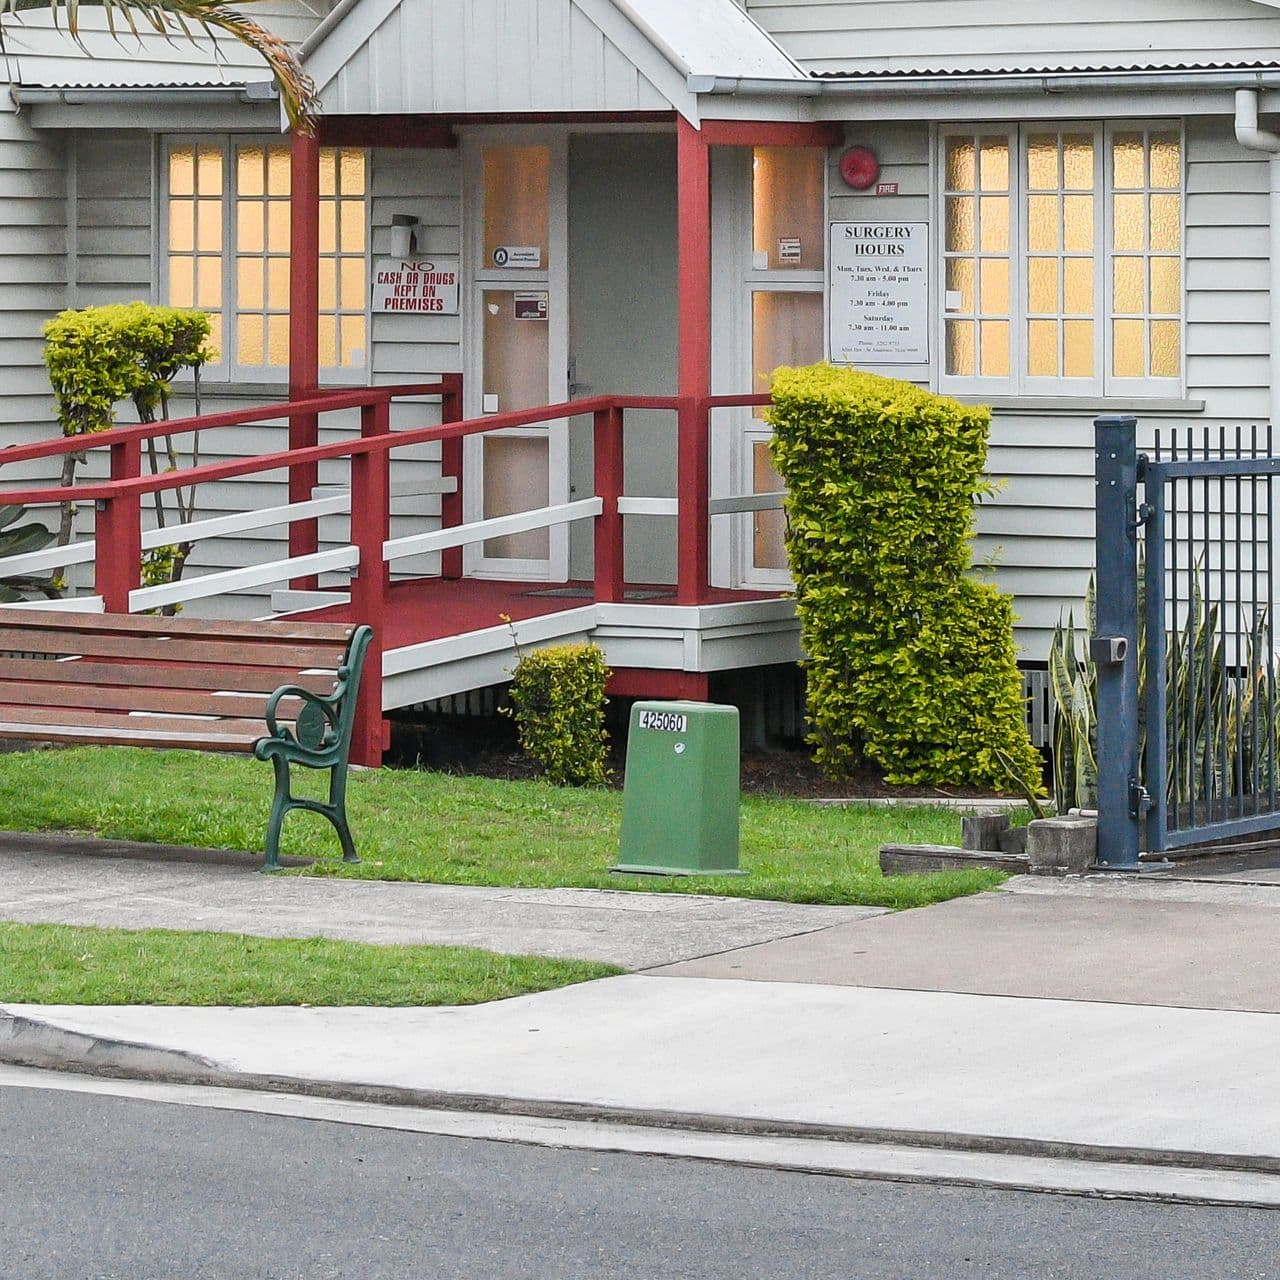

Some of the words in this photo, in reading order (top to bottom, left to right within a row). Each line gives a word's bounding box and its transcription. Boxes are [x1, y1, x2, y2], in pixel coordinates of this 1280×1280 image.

[844, 226, 914, 238] SURGERY
[855, 243, 905, 255] HOURS
[401, 262, 435, 272] NO
[377, 272, 402, 285] CASH
[406, 272, 419, 285] OR
[423, 272, 455, 285] DRUGS
[394, 285, 417, 297] KEPT
[422, 285, 436, 298] ON
[867, 290, 890, 298] Friday
[384, 298, 444, 311] PREMISES
[863, 314, 894, 323] Saturday
[642, 712, 683, 732] 425060
